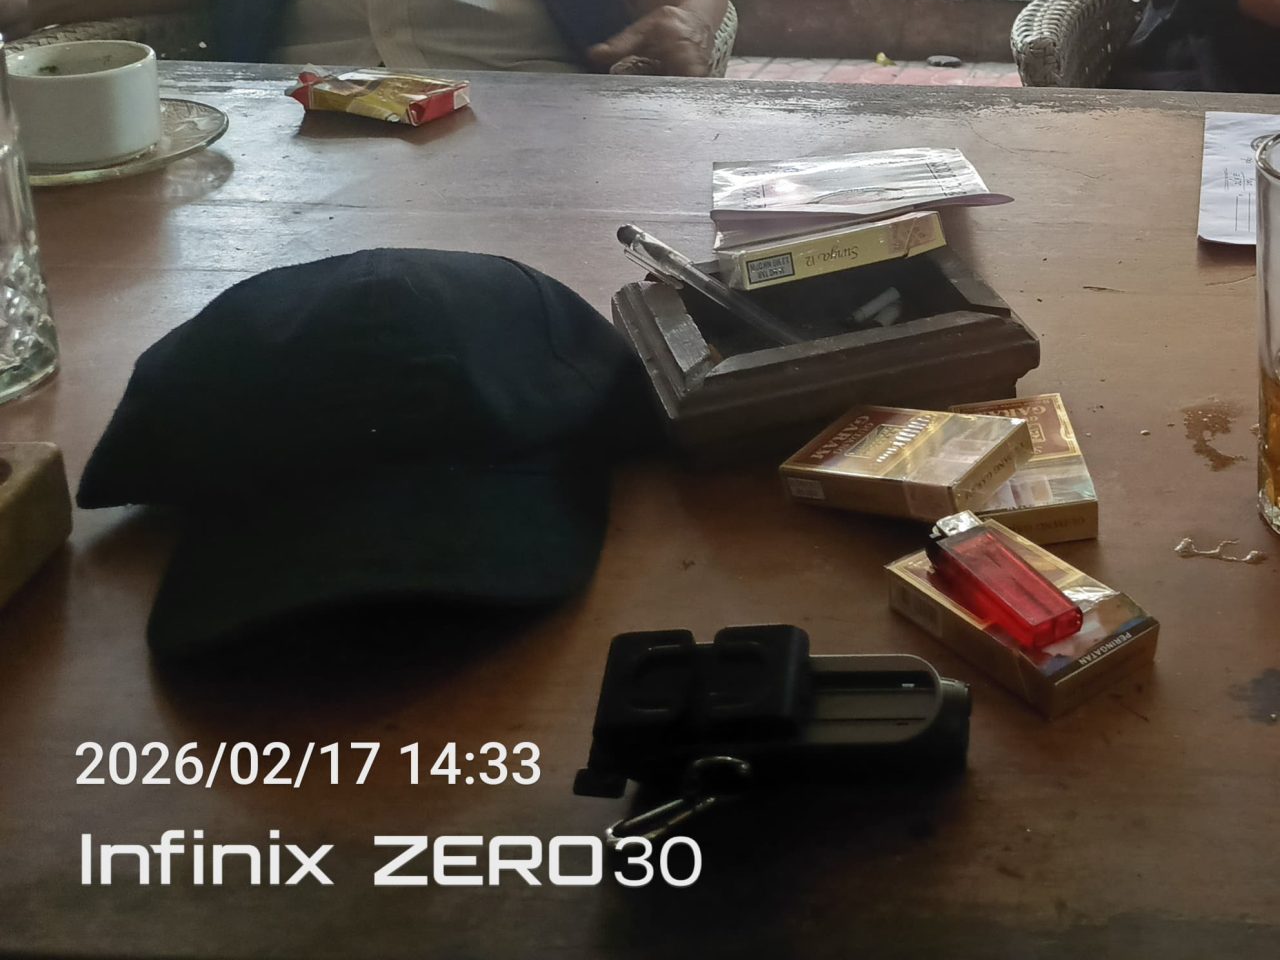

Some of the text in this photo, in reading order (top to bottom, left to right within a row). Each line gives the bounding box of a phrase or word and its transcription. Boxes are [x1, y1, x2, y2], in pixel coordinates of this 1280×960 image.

[804, 255, 817, 268] 12
[984, 405, 1047, 418] GARA
[811, 415, 870, 459] GARAM
[1078, 631, 1133, 665] PERINGATAN
